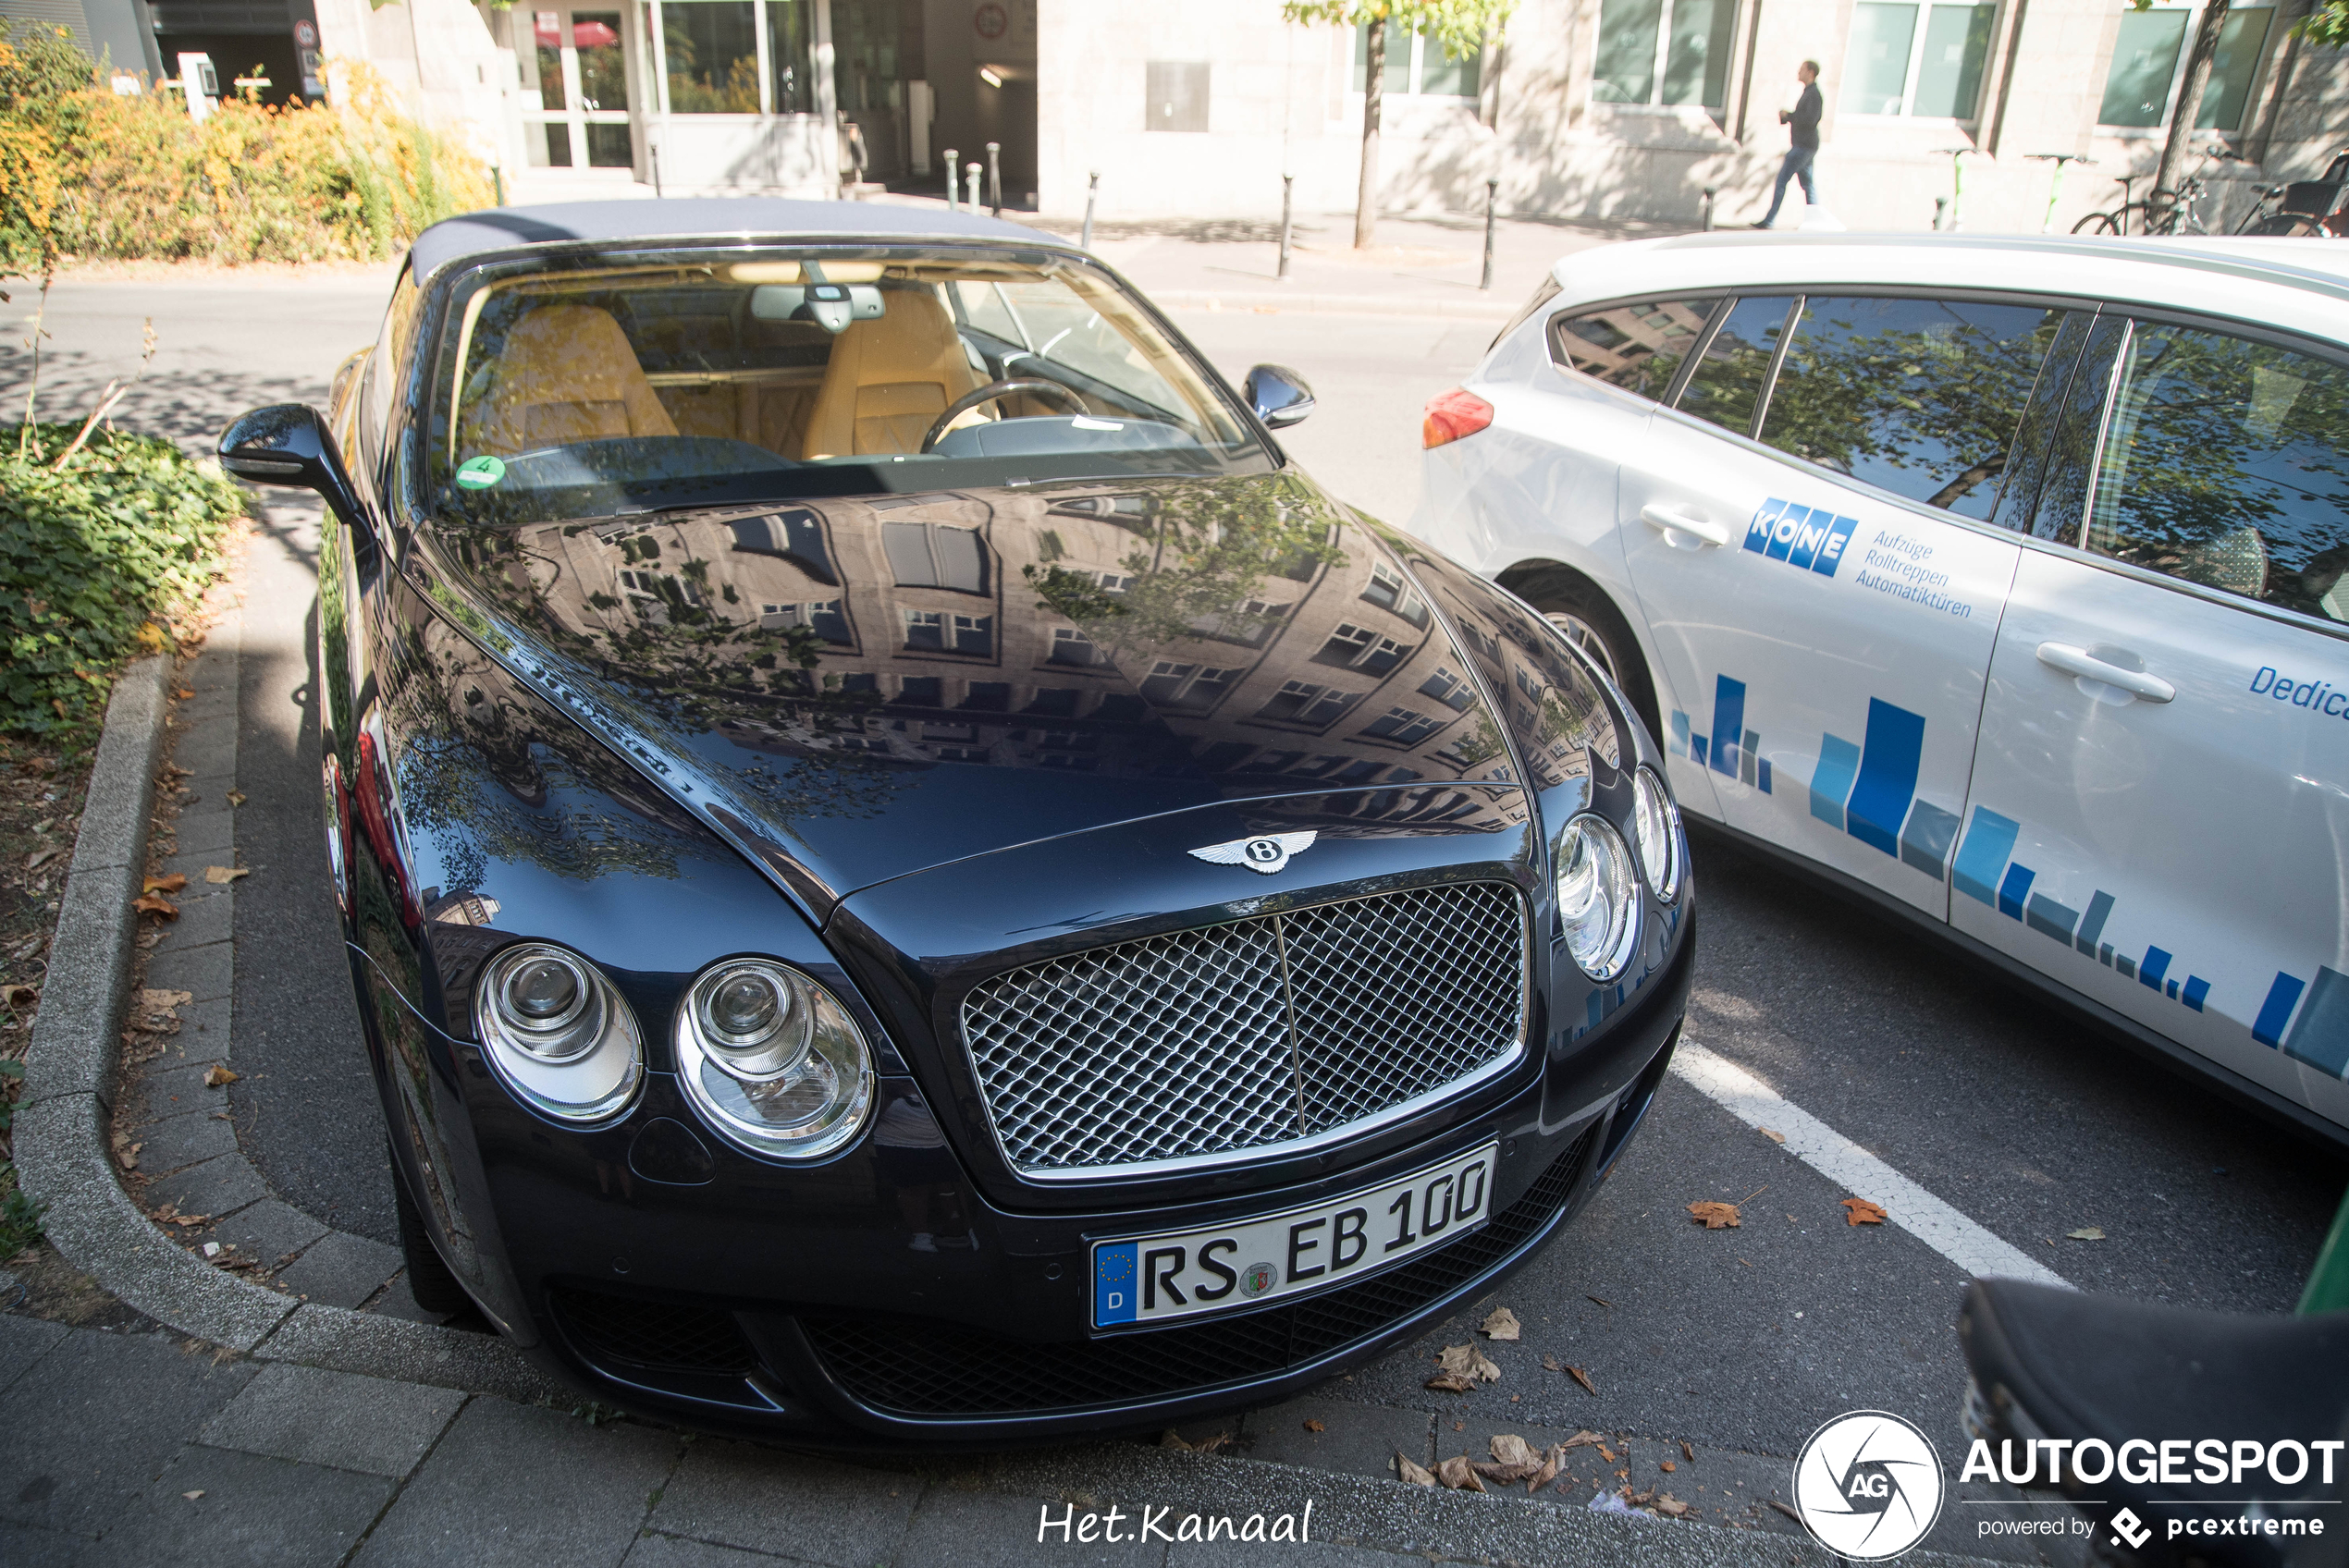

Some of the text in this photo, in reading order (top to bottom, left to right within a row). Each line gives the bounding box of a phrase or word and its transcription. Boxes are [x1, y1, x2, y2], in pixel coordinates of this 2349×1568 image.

[475, 457, 493, 472] 4
[1751, 509, 1848, 559] KONE
[1873, 530, 1933, 561] Aufzüge
[1864, 549, 1949, 587] Rolltreppen
[1855, 569, 1972, 619] Automatiktüren
[1249, 840, 1278, 861] B
[1143, 1159, 1486, 1309] RS EB 100
[1109, 1292, 1123, 1309] D
